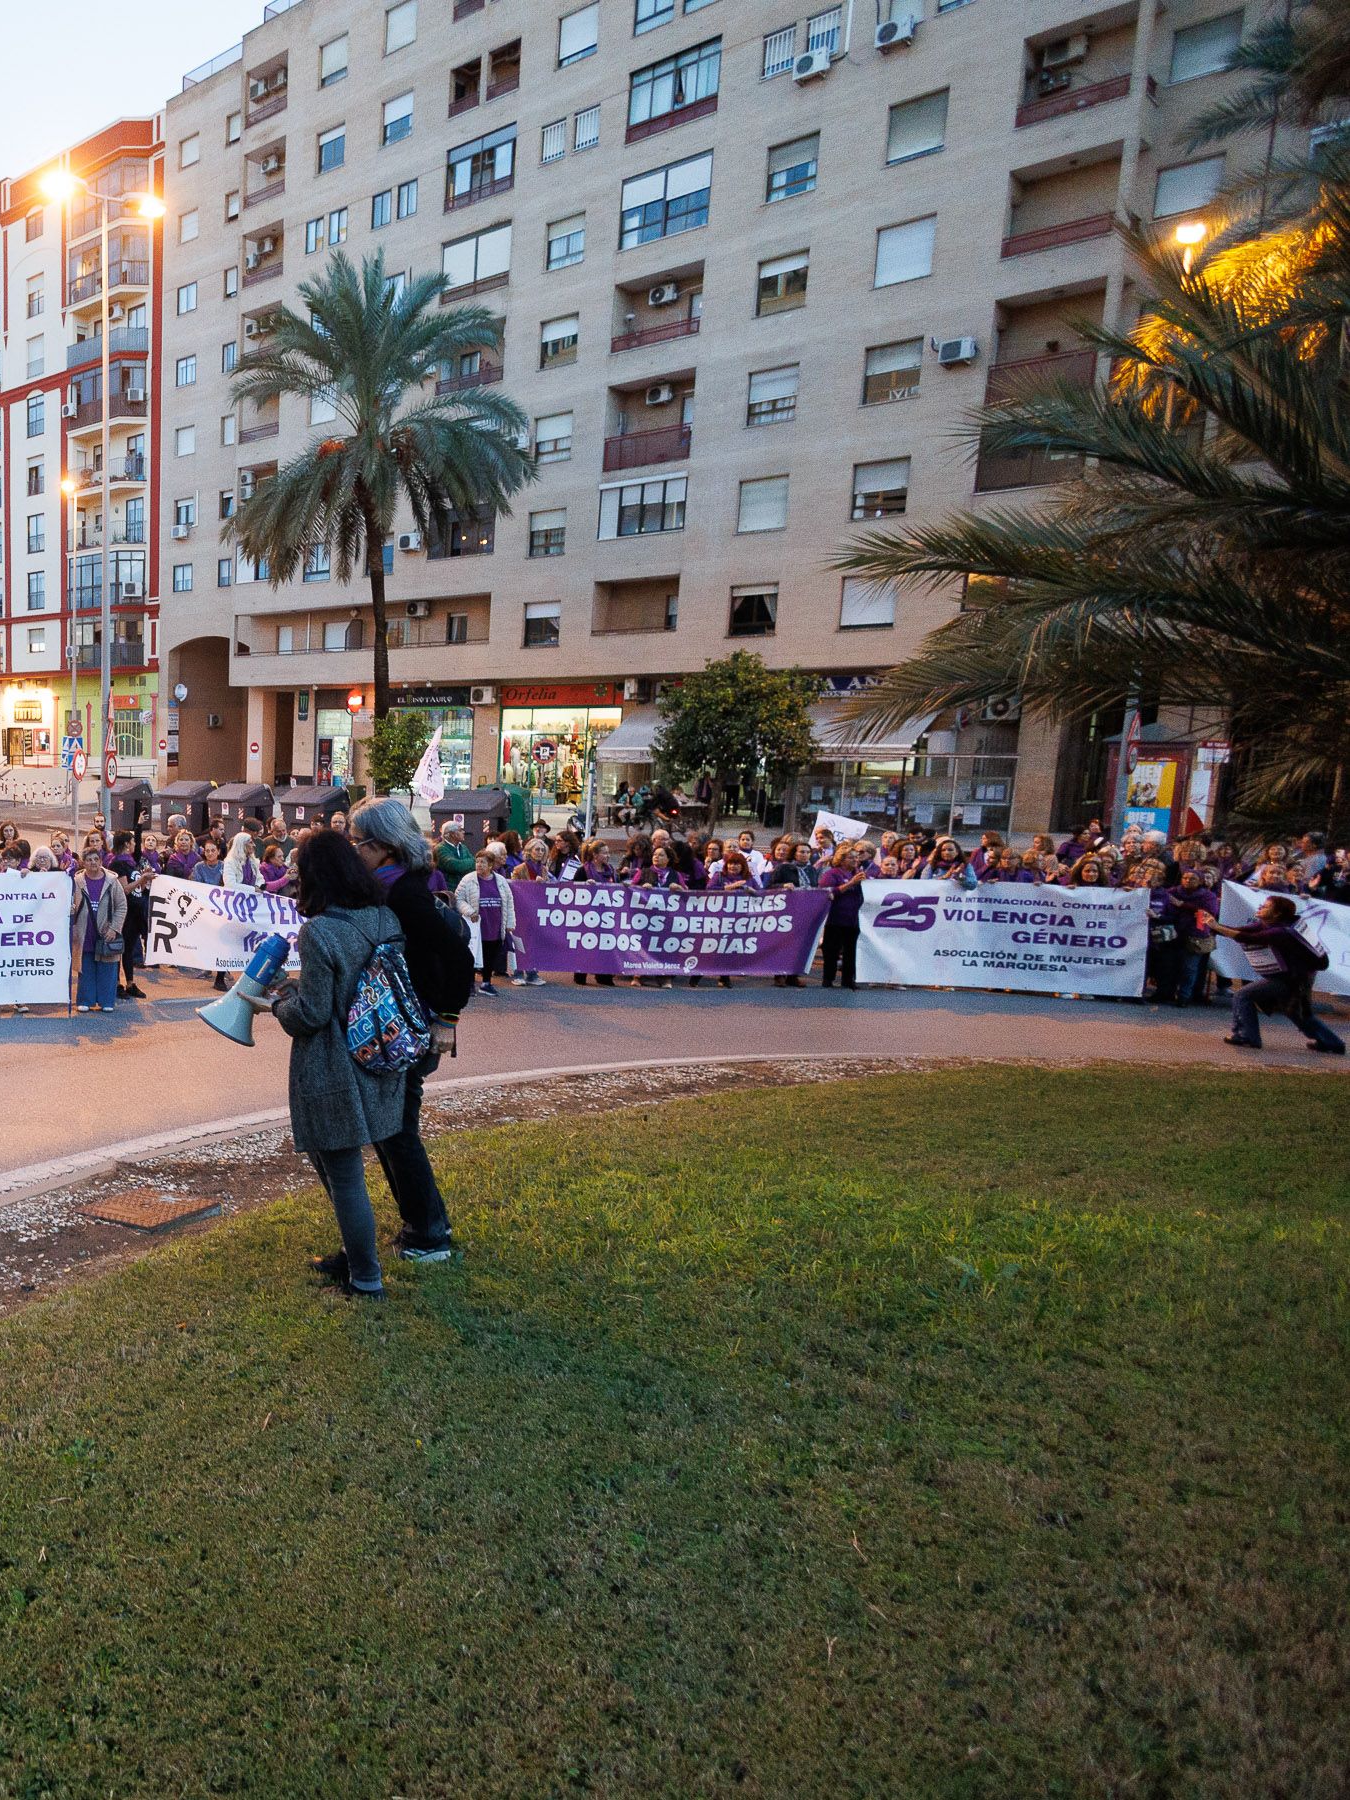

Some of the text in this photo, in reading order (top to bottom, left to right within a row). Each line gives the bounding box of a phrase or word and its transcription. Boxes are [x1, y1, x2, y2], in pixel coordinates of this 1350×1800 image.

[506, 688, 557, 704] Orfelia
[209, 888, 306, 924] STOP TER
[546, 888, 787, 913] TODAS LAS MUJERES
[945, 894, 962, 903] DÍA
[965, 897, 1057, 908] INTERNACIONAL
[1058, 900, 1114, 910] CONTRA
[12, 914, 34, 924] DE
[537, 908, 793, 934] TODOS LOS DERECHOS
[873, 892, 939, 932] 25
[943, 909, 1107, 930] VIOLENCIA DE
[566, 932, 758, 954] TODOS LOS DÍAS
[1012, 928, 1128, 949] GÉNERO
[933, 948, 1126, 966] ASOCIACIÓN DE MUJERES
[962, 959, 1068, 973] LA MARQUESA
